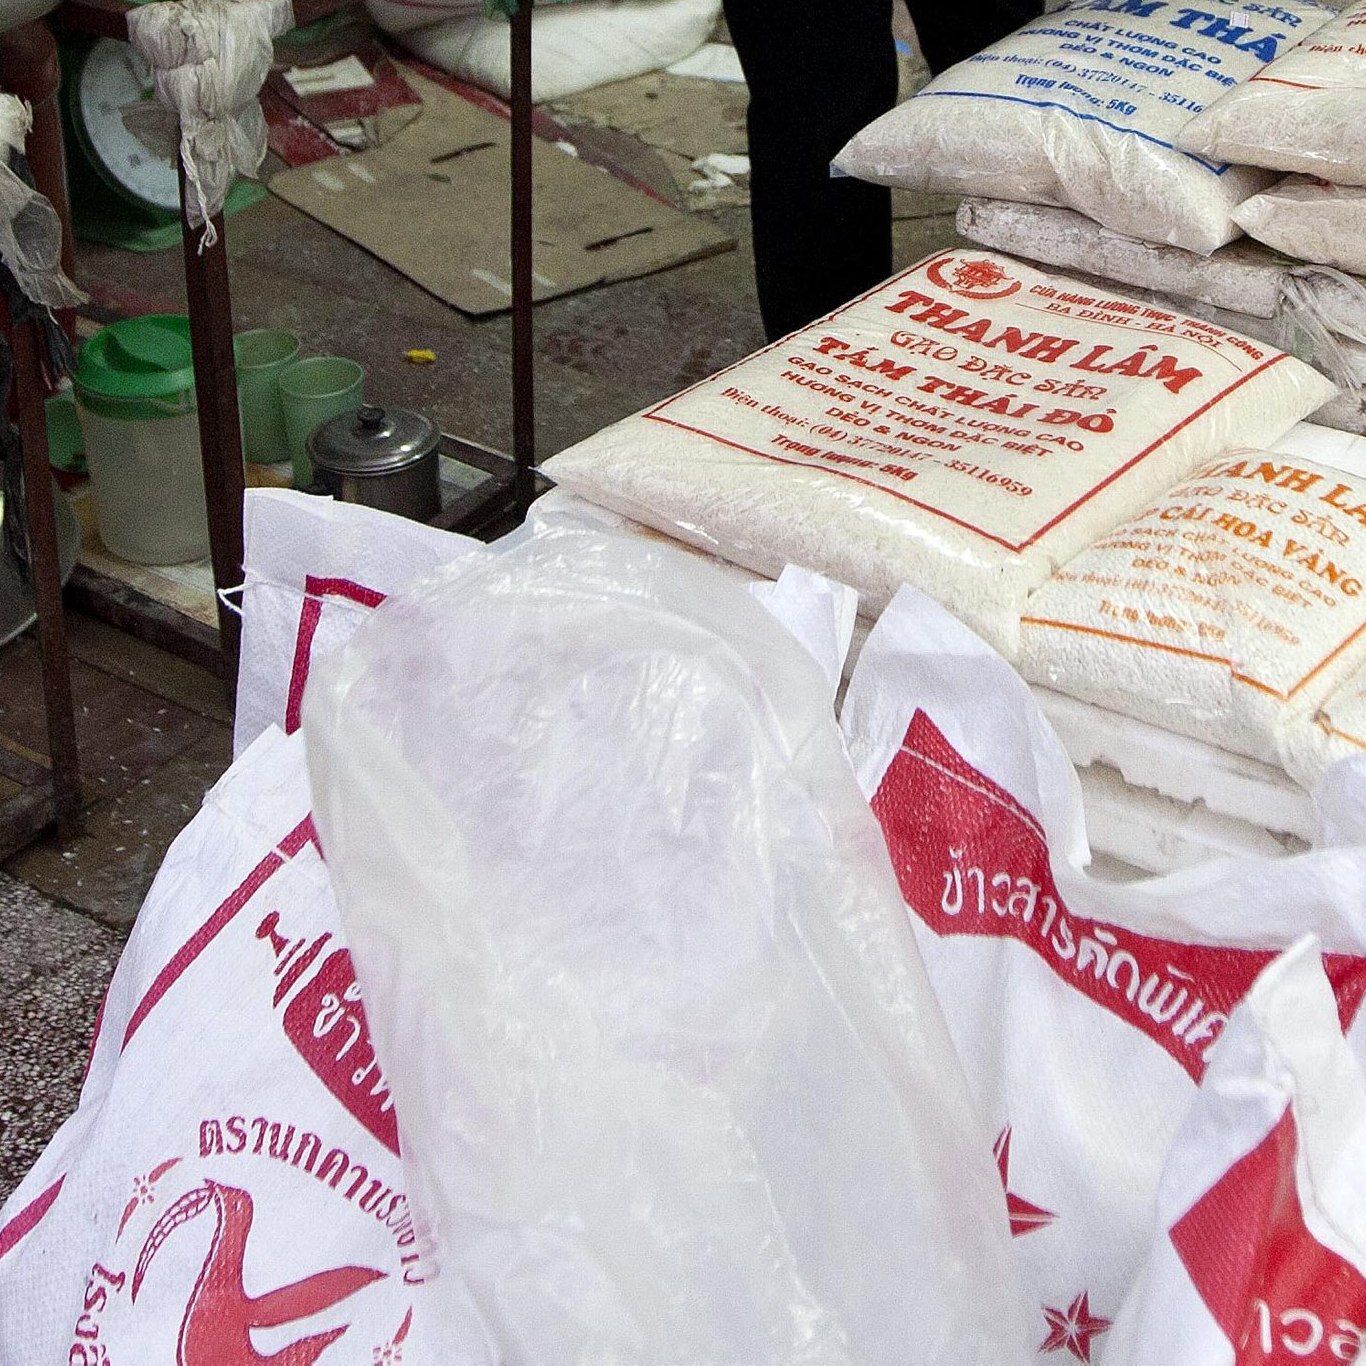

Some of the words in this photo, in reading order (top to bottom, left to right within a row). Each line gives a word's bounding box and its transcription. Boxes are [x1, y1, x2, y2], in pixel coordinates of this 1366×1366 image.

[1119, 55, 1176, 79] NGON
[1182, 46, 1223, 66] CAO
[1108, 98, 1139, 118] 5Kg
[883, 289, 1076, 366] THANH
[1077, 339, 1204, 395] LÂM
[1072, 302, 1132, 327] ĐÌNH
[1181, 327, 1225, 352] NỘI
[812, 335, 918, 382] TÁM
[917, 374, 1040, 420] THÁI
[1036, 407, 1118, 435] ĐỎ
[890, 329, 959, 362] GẠO
[961, 353, 1030, 387] ĐẶC
[780, 369, 857, 405] HƯƠNG
[859, 399, 885, 416] VỊ
[884, 408, 950, 436] THƠM
[948, 428, 1002, 449] ĐẶC
[1001, 437, 1056, 460] BIỆT
[787, 355, 833, 378] GẠO
[834, 373, 894, 400] SẠCH
[894, 393, 958, 422] CHẤT
[955, 415, 1036, 442] LƯỢNG
[1037, 428, 1084, 453] CAO
[824, 404, 873, 429] DẺO
[894, 430, 964, 456] NGON
[719, 386, 760, 410] Điện
[760, 403, 811, 430] thoại:
[810, 422, 848, 444] (04)
[943, 457, 1035, 498] 35116959
[770, 433, 822, 459] Trọng
[879, 461, 920, 484] 5Kg
[1159, 503, 1209, 523] CÁI
[1211, 511, 1276, 551] HOA
[1282, 537, 1365, 601] VÀNG
